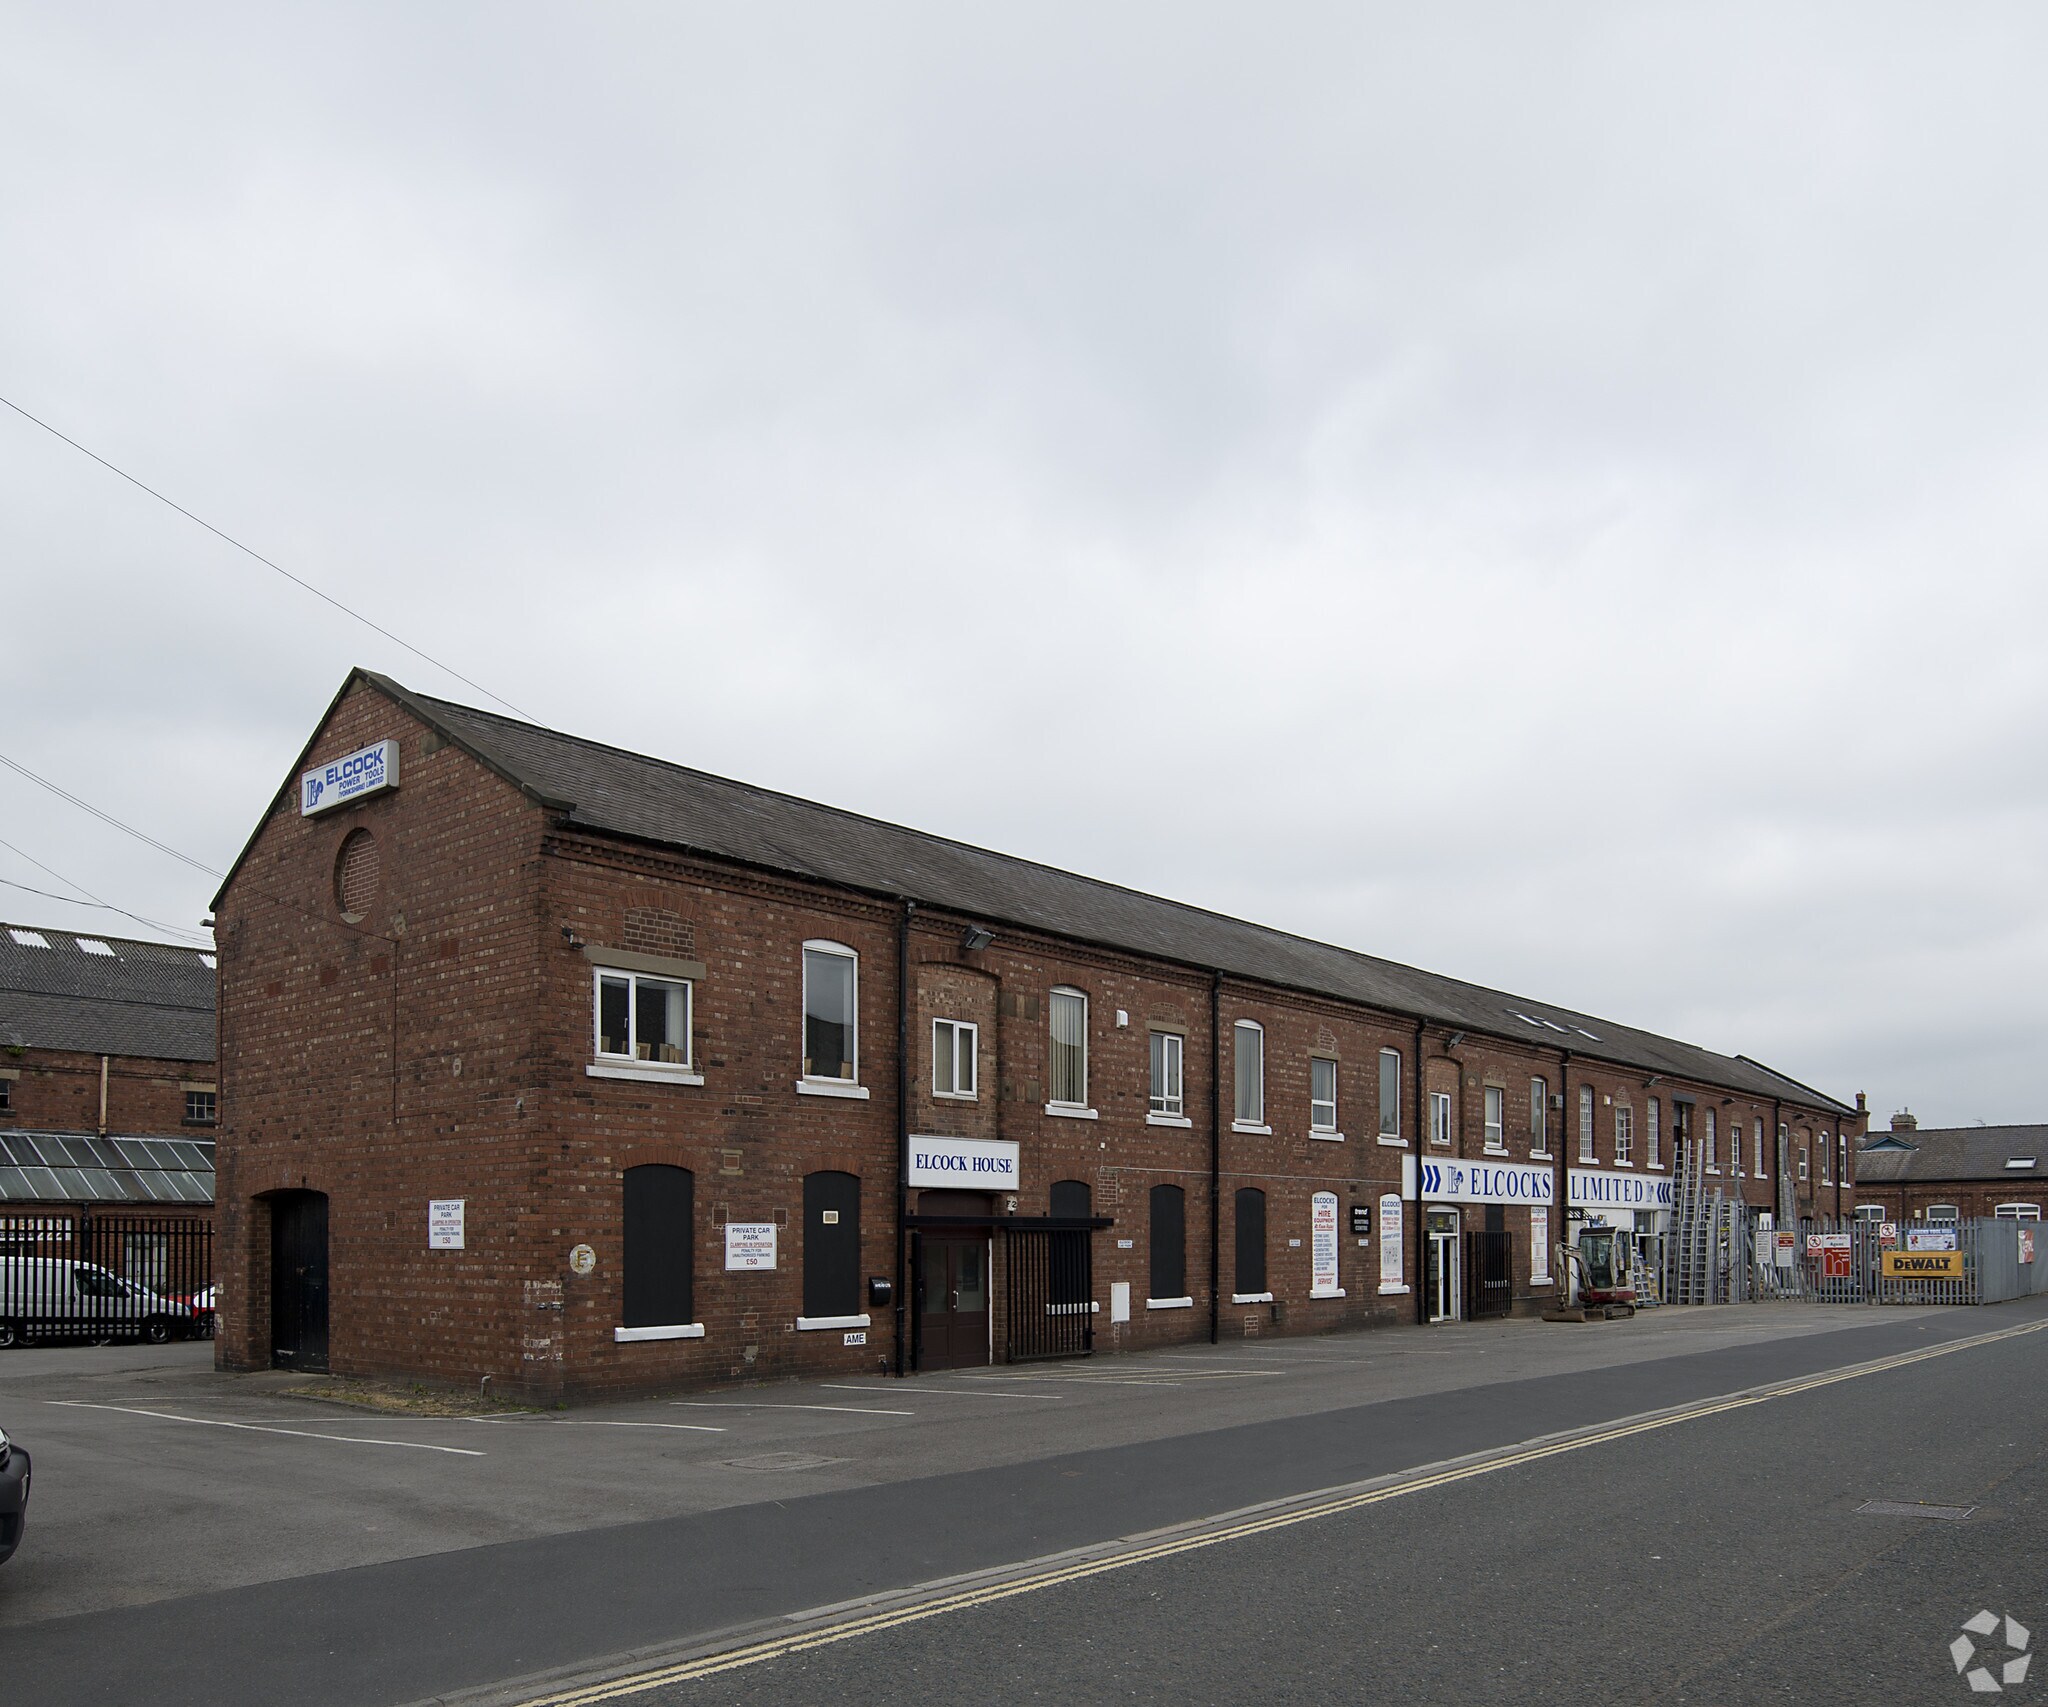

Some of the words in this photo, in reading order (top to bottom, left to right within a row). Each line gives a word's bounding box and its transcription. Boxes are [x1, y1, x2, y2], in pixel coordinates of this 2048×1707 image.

[326, 747, 384, 786] ELCOCK
[339, 776, 360, 790] POWER
[365, 766, 384, 780] TOOLS
[366, 776, 384, 788] LIMITED
[916, 1154, 968, 1171] ELCOCK
[972, 1157, 1012, 1173] HOUSE
[1470, 1168, 1551, 1198] ELCOCKS
[1571, 1176, 1643, 1202] LIMITED
[846, 1334, 864, 1343] AME
